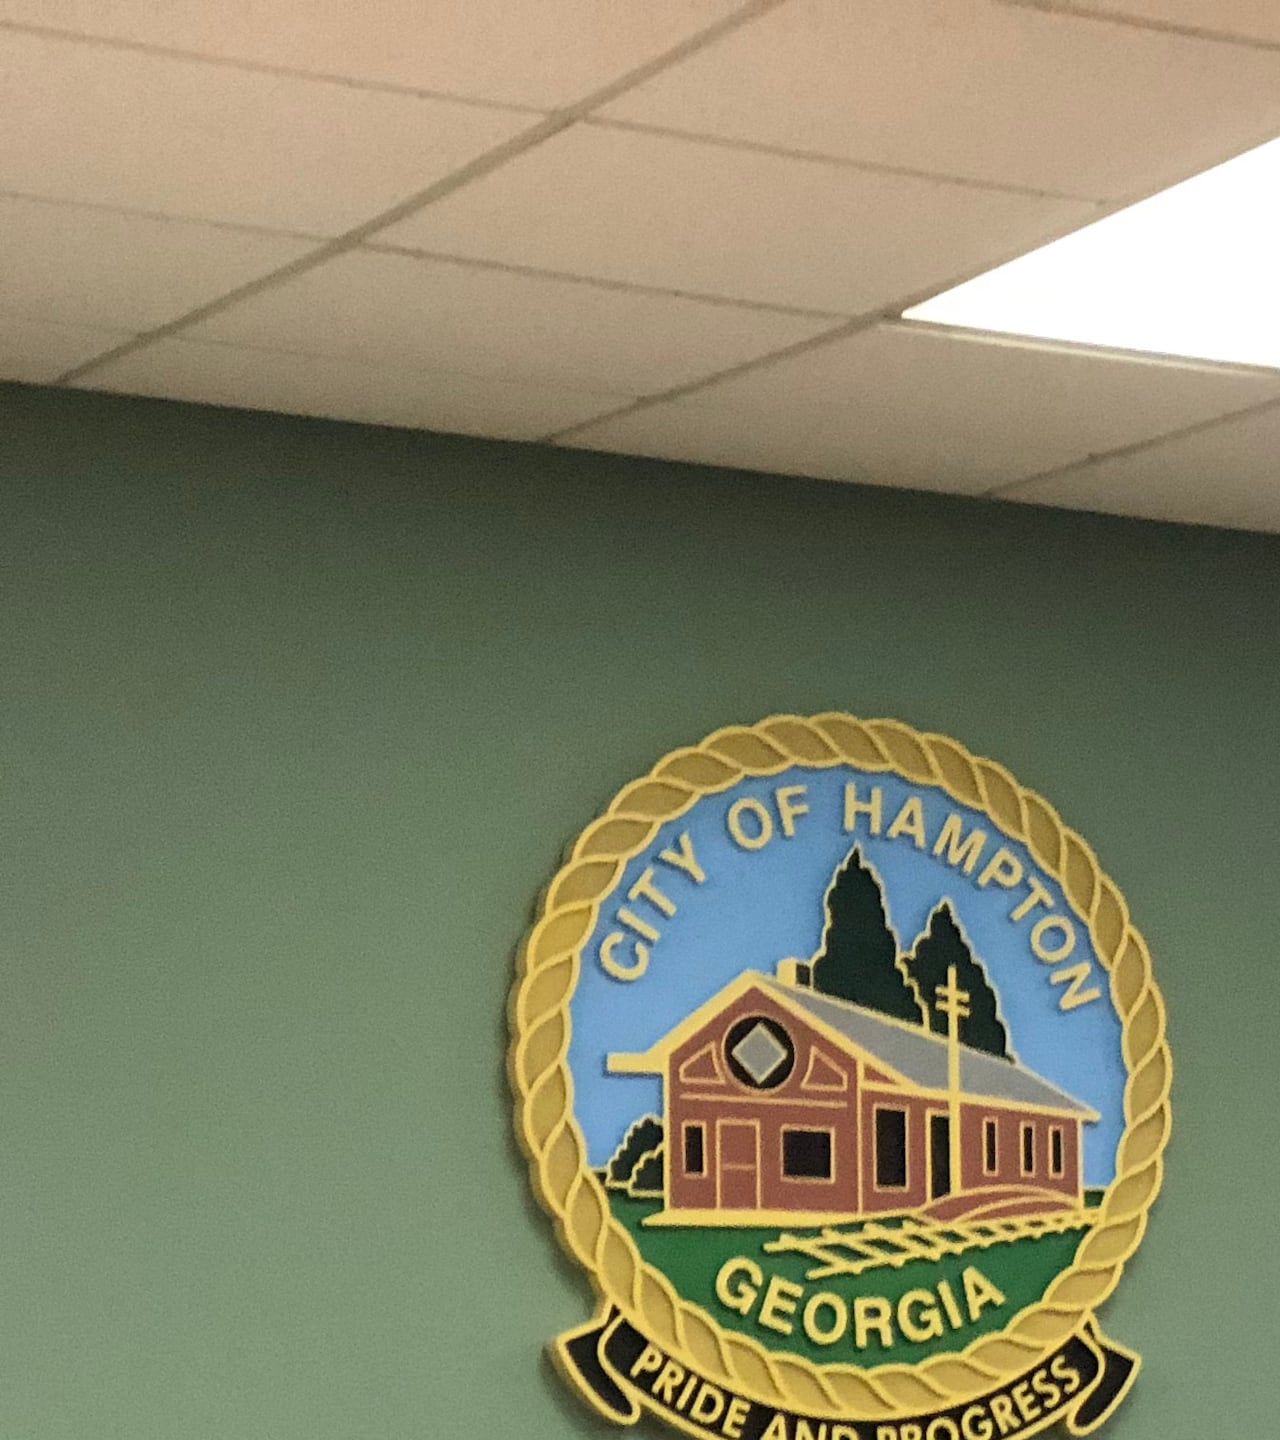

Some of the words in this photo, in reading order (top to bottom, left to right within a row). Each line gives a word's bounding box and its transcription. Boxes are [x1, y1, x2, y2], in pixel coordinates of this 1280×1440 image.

[599, 835, 710, 984] CITY
[726, 783, 811, 845] OF
[843, 781, 1101, 1013] HAMPTON
[714, 1257, 1006, 1349] GEORGIA
[629, 1345, 749, 1438] PRIDE
